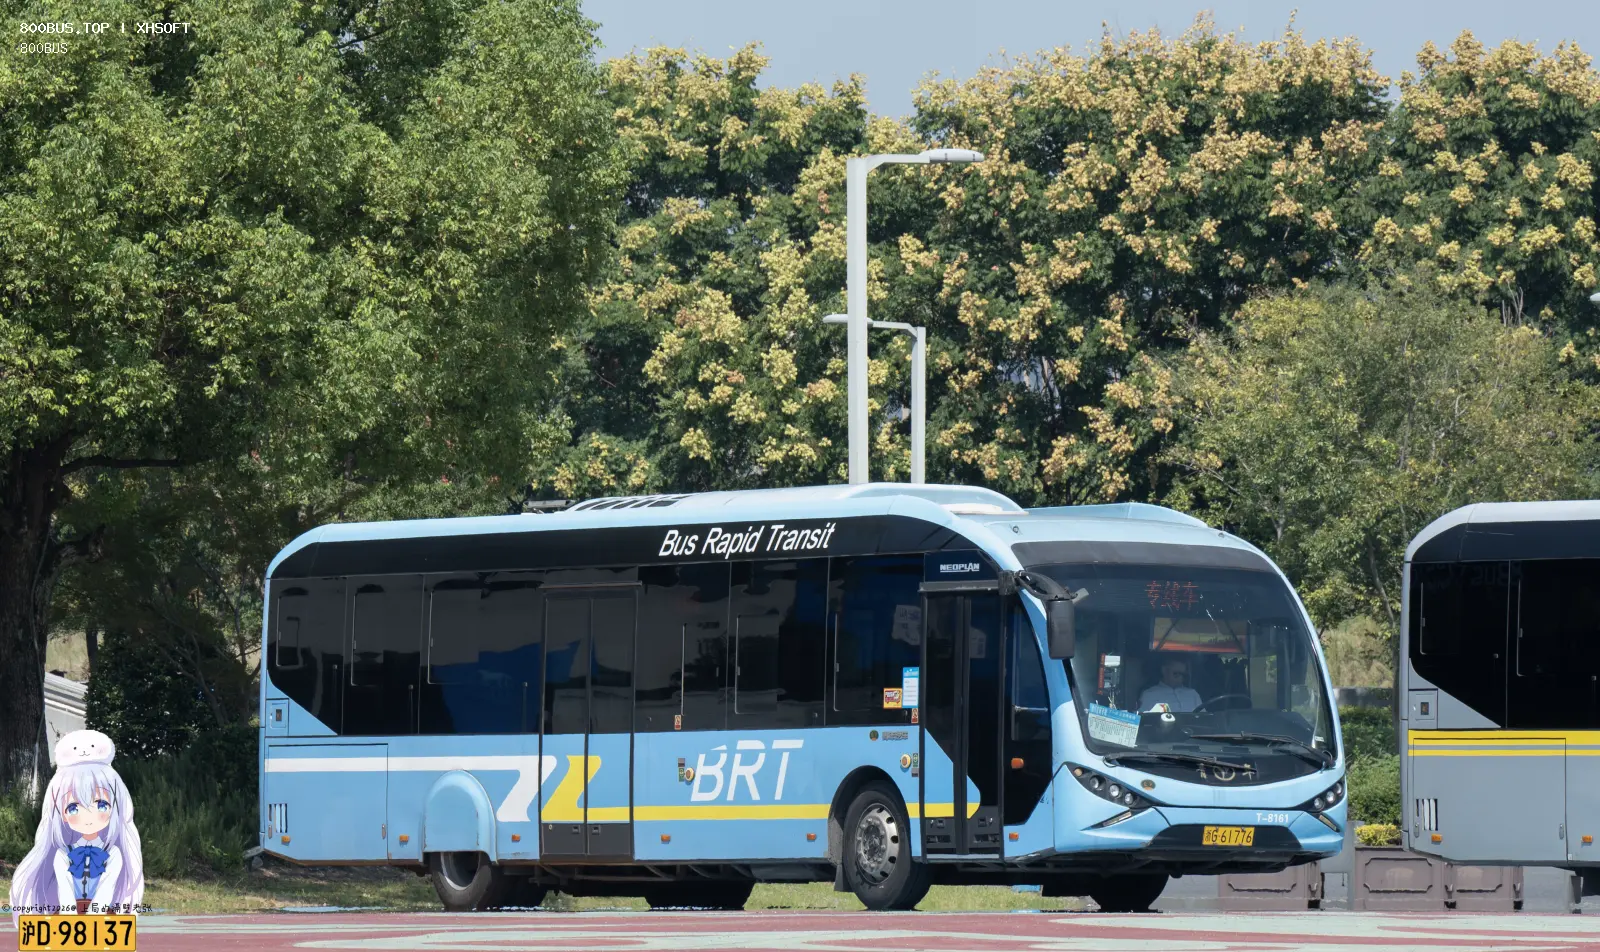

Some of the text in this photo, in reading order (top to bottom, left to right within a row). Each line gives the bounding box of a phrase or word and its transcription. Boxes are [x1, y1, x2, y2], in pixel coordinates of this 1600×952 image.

[658, 522, 837, 560] Bus Rapid Transit
[939, 562, 980, 573] NEOPLAN
[690, 739, 804, 802] BRT
[1256, 812, 1289, 823] T-8161
